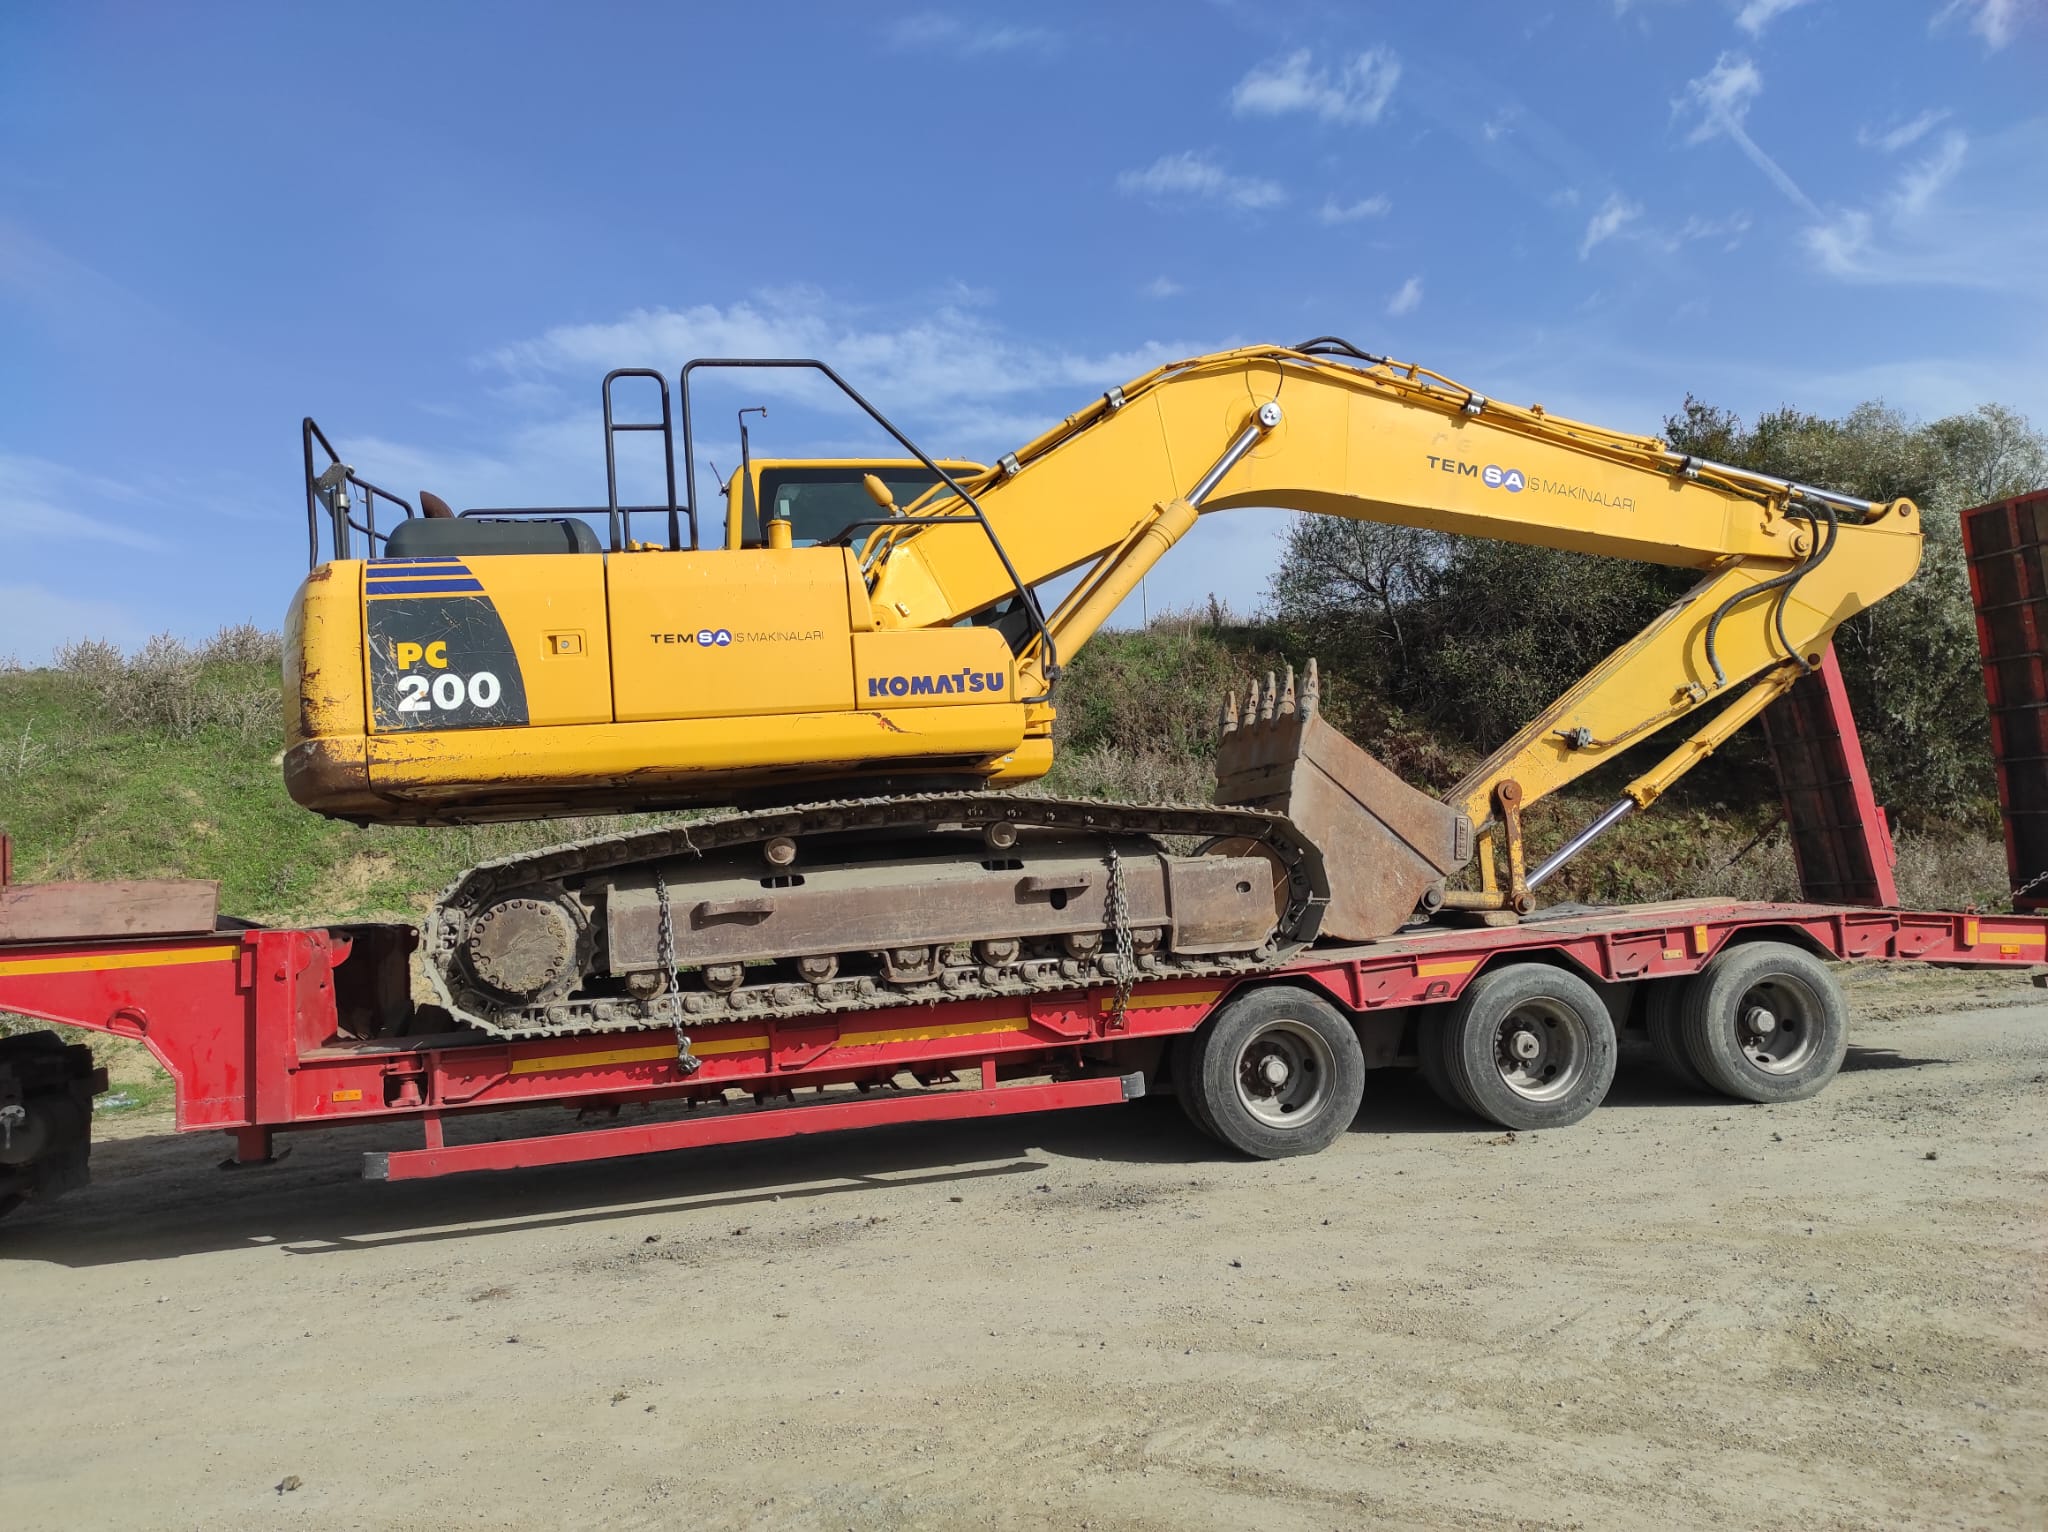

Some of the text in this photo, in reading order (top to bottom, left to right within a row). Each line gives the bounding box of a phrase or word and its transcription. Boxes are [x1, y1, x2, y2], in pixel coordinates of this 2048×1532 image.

[1426, 455, 1525, 493] TEMSA
[650, 629, 732, 647] TEMSA
[397, 641, 448, 670] PC
[397, 671, 501, 712] 200
[868, 667, 1004, 697] KOMATSU
